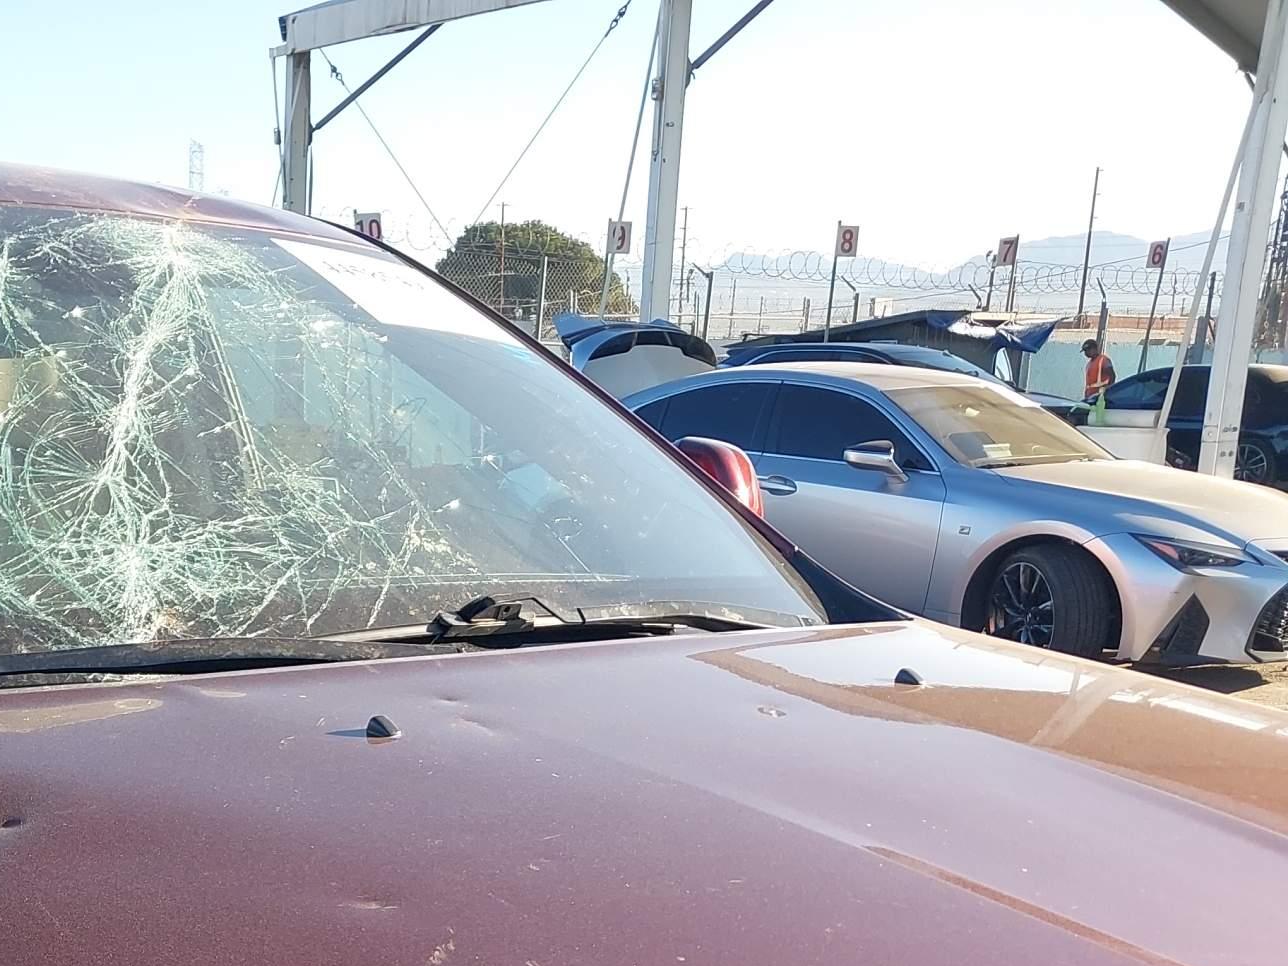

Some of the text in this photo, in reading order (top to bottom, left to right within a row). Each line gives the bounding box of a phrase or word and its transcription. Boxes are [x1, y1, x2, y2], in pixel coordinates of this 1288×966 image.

[356, 218, 382, 240] 10
[612, 224, 626, 251] 9
[840, 228, 854, 254] 8
[1002, 239, 1015, 263] 7
[1151, 243, 1164, 266] 6
